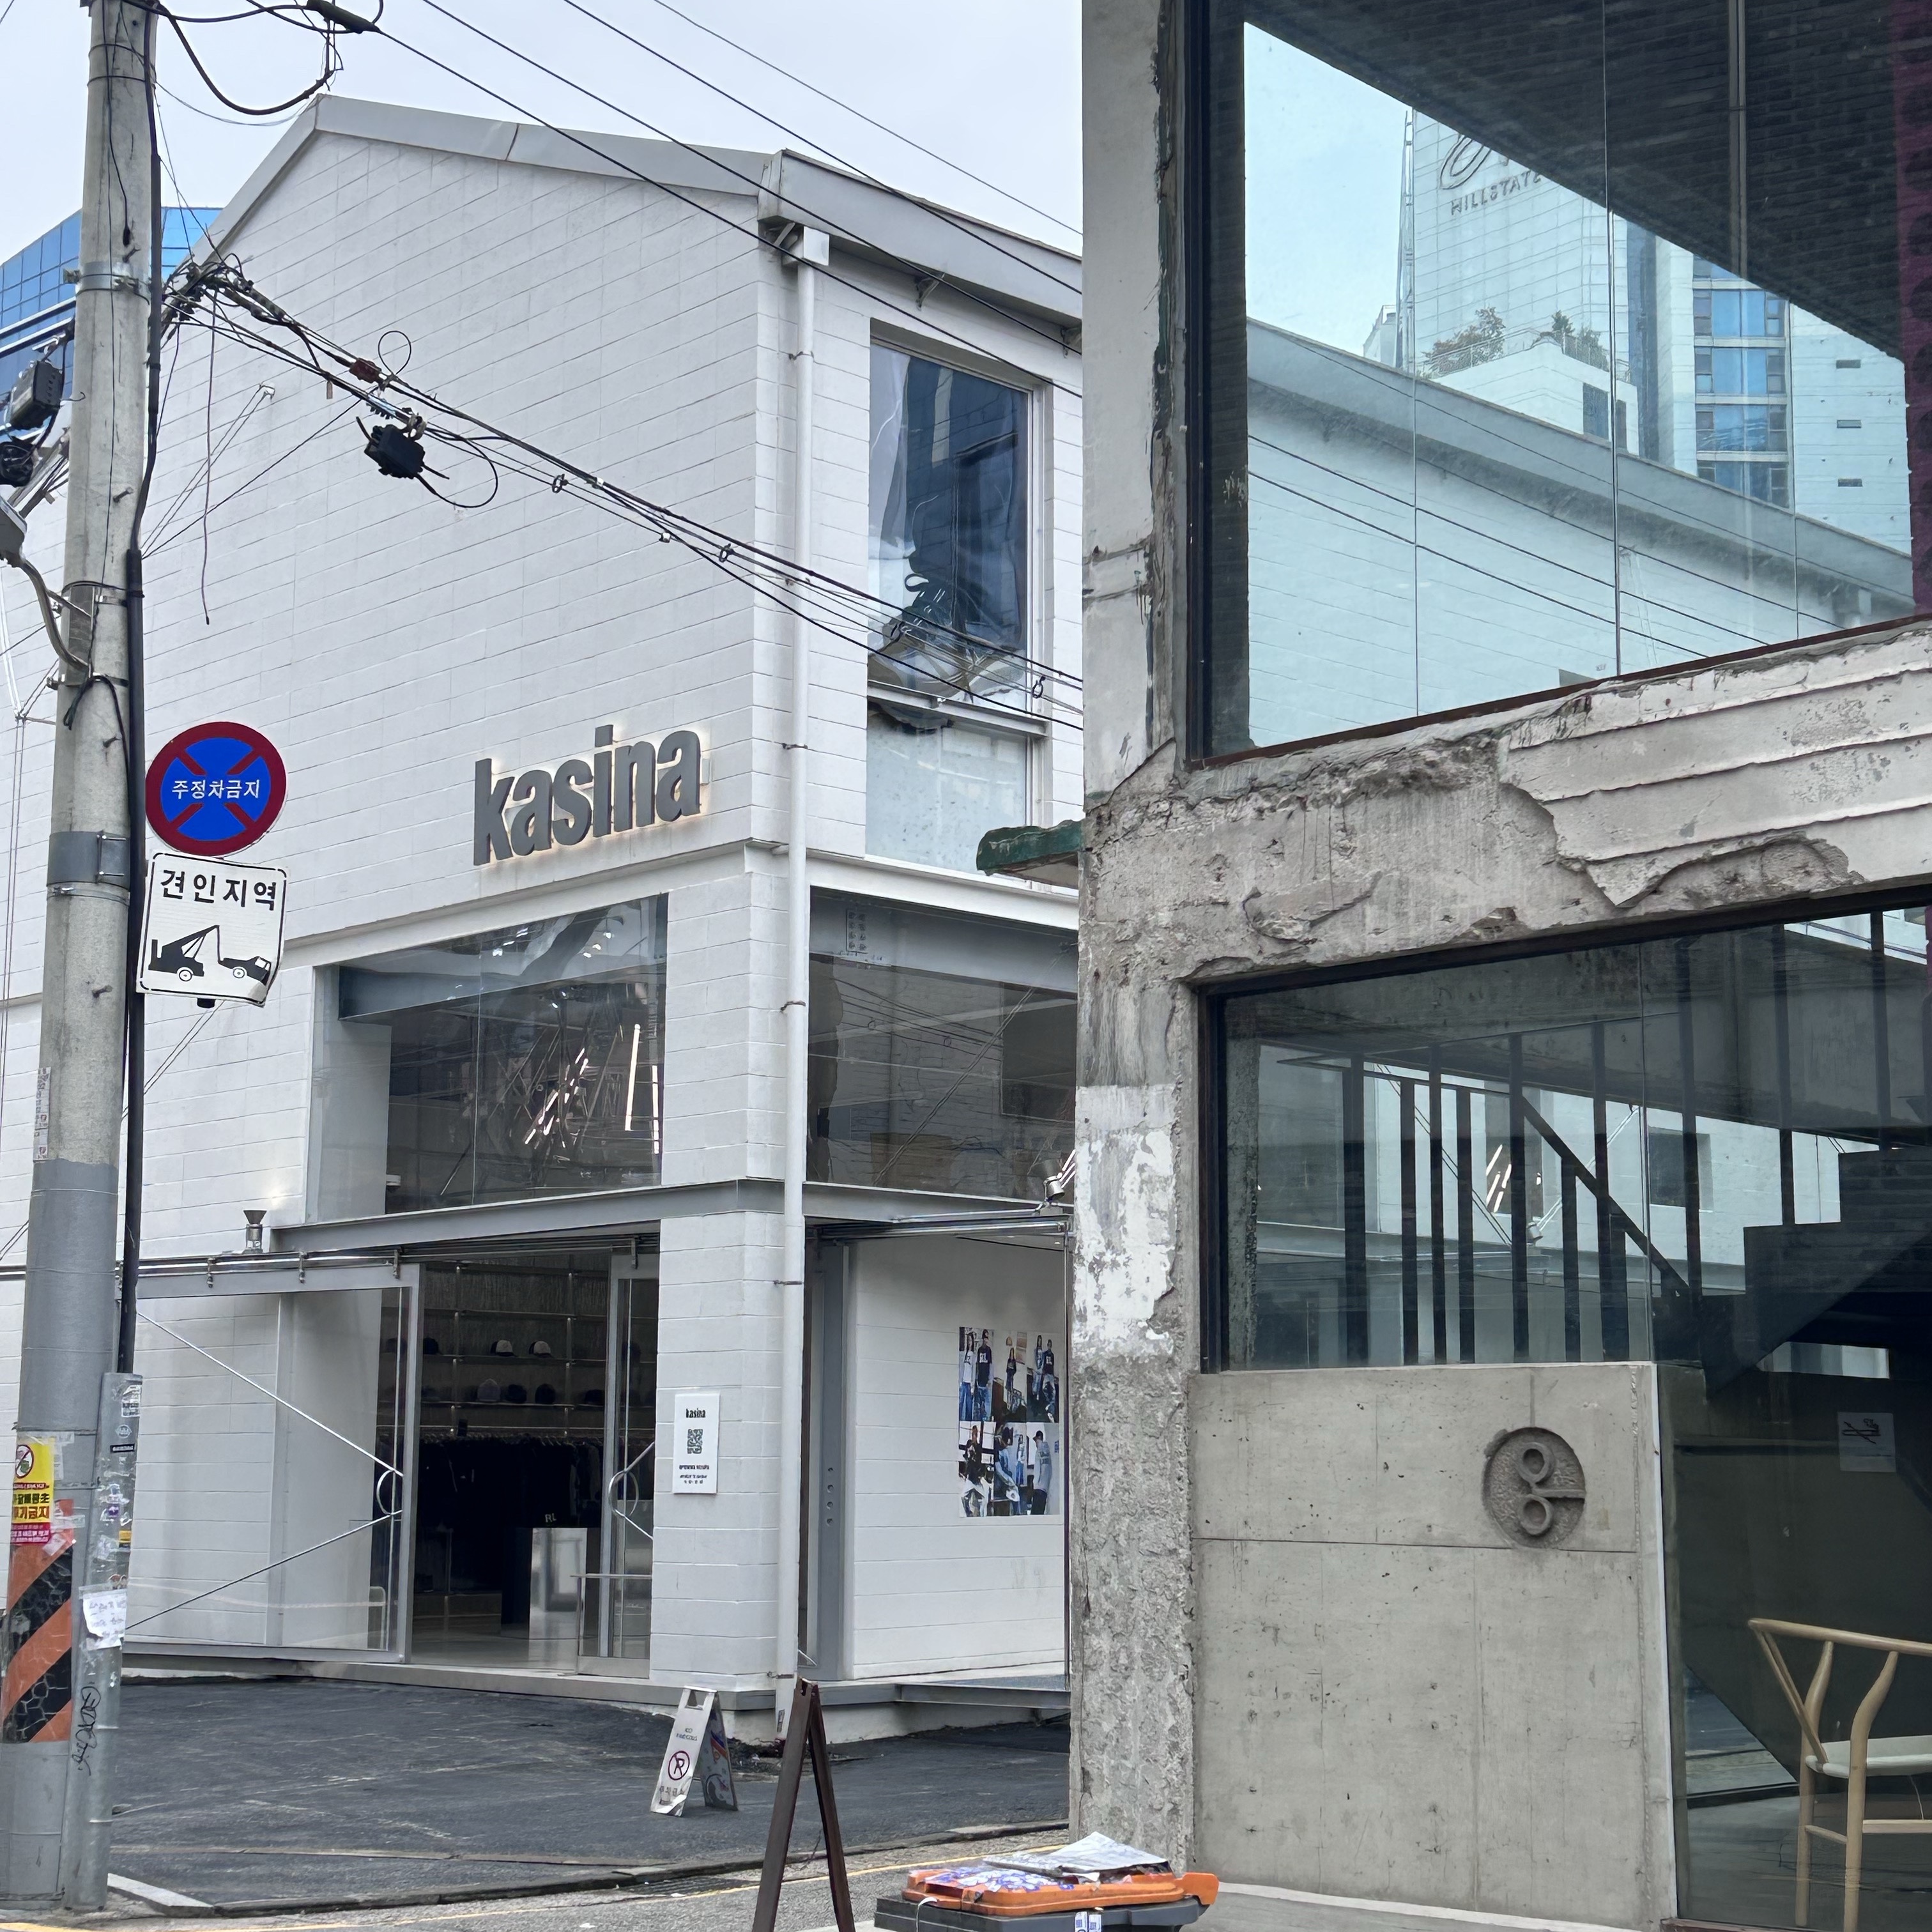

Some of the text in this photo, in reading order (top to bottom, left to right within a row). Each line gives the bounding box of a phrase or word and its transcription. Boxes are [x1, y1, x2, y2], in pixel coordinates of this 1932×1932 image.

[172, 779, 260, 799] 주정차금지
[473, 724, 701, 866] kasina
[161, 870, 277, 911] 견인지역
